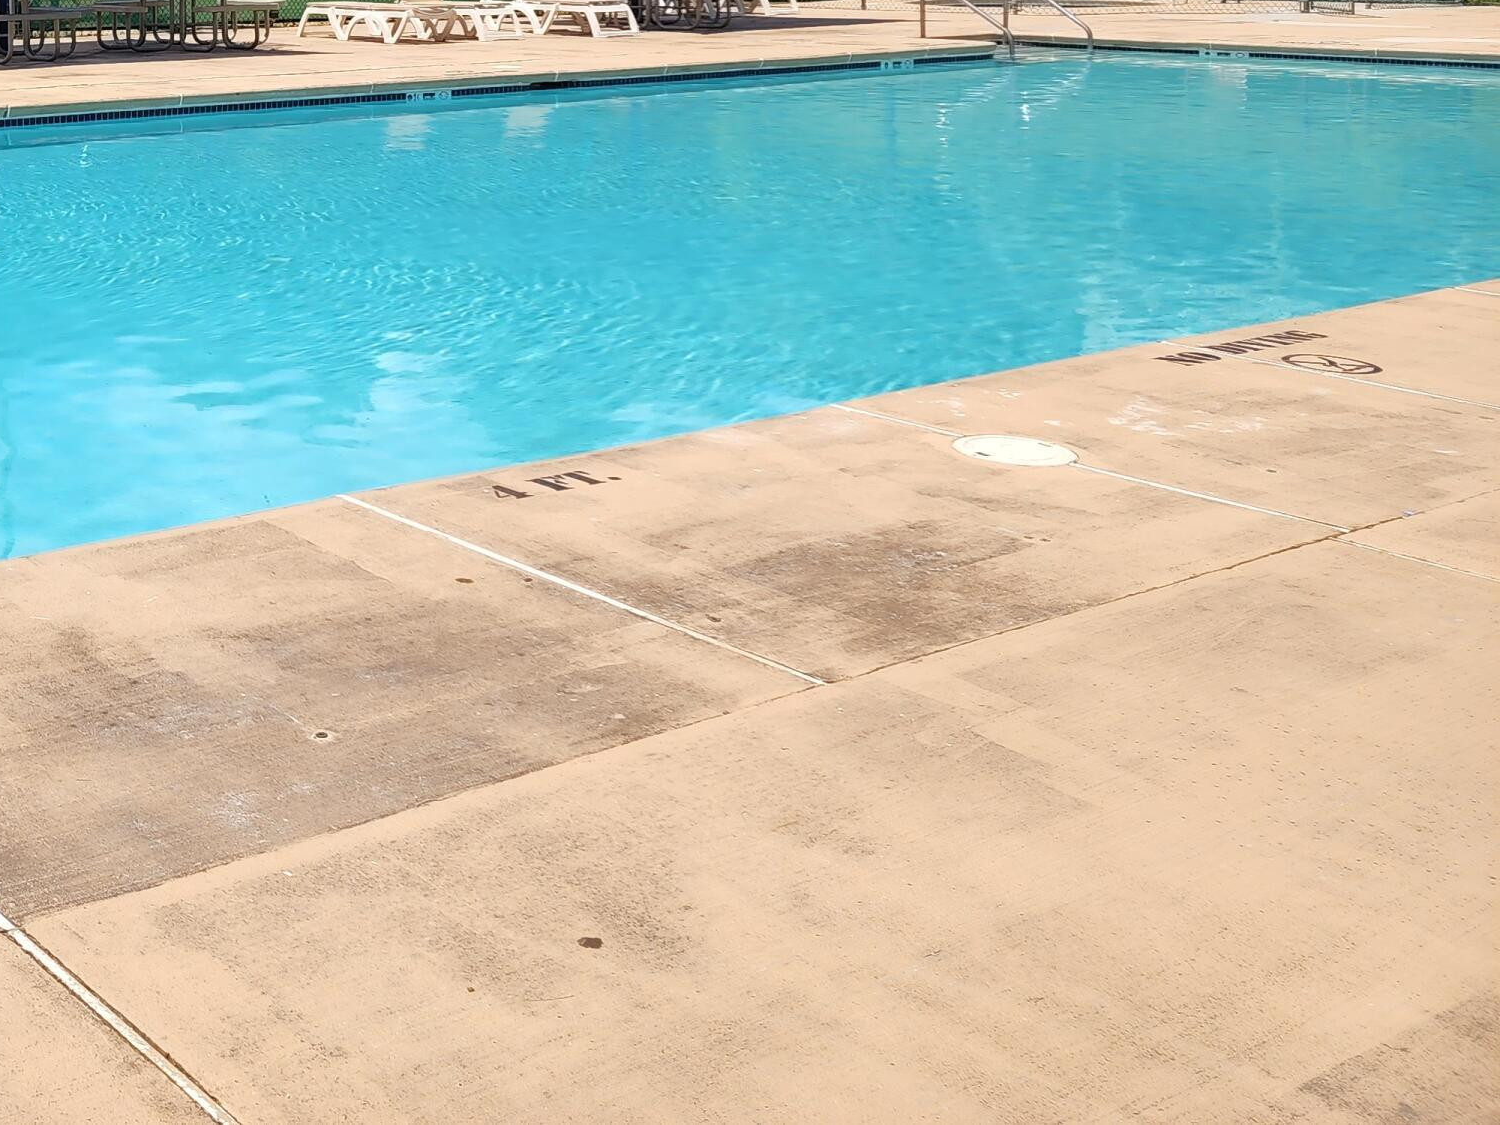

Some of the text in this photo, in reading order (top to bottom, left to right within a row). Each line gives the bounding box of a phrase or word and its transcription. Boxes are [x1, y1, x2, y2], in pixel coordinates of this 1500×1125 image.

[1153, 330, 1329, 367] NO DIVING
[491, 470, 622, 499] 4 FT.
